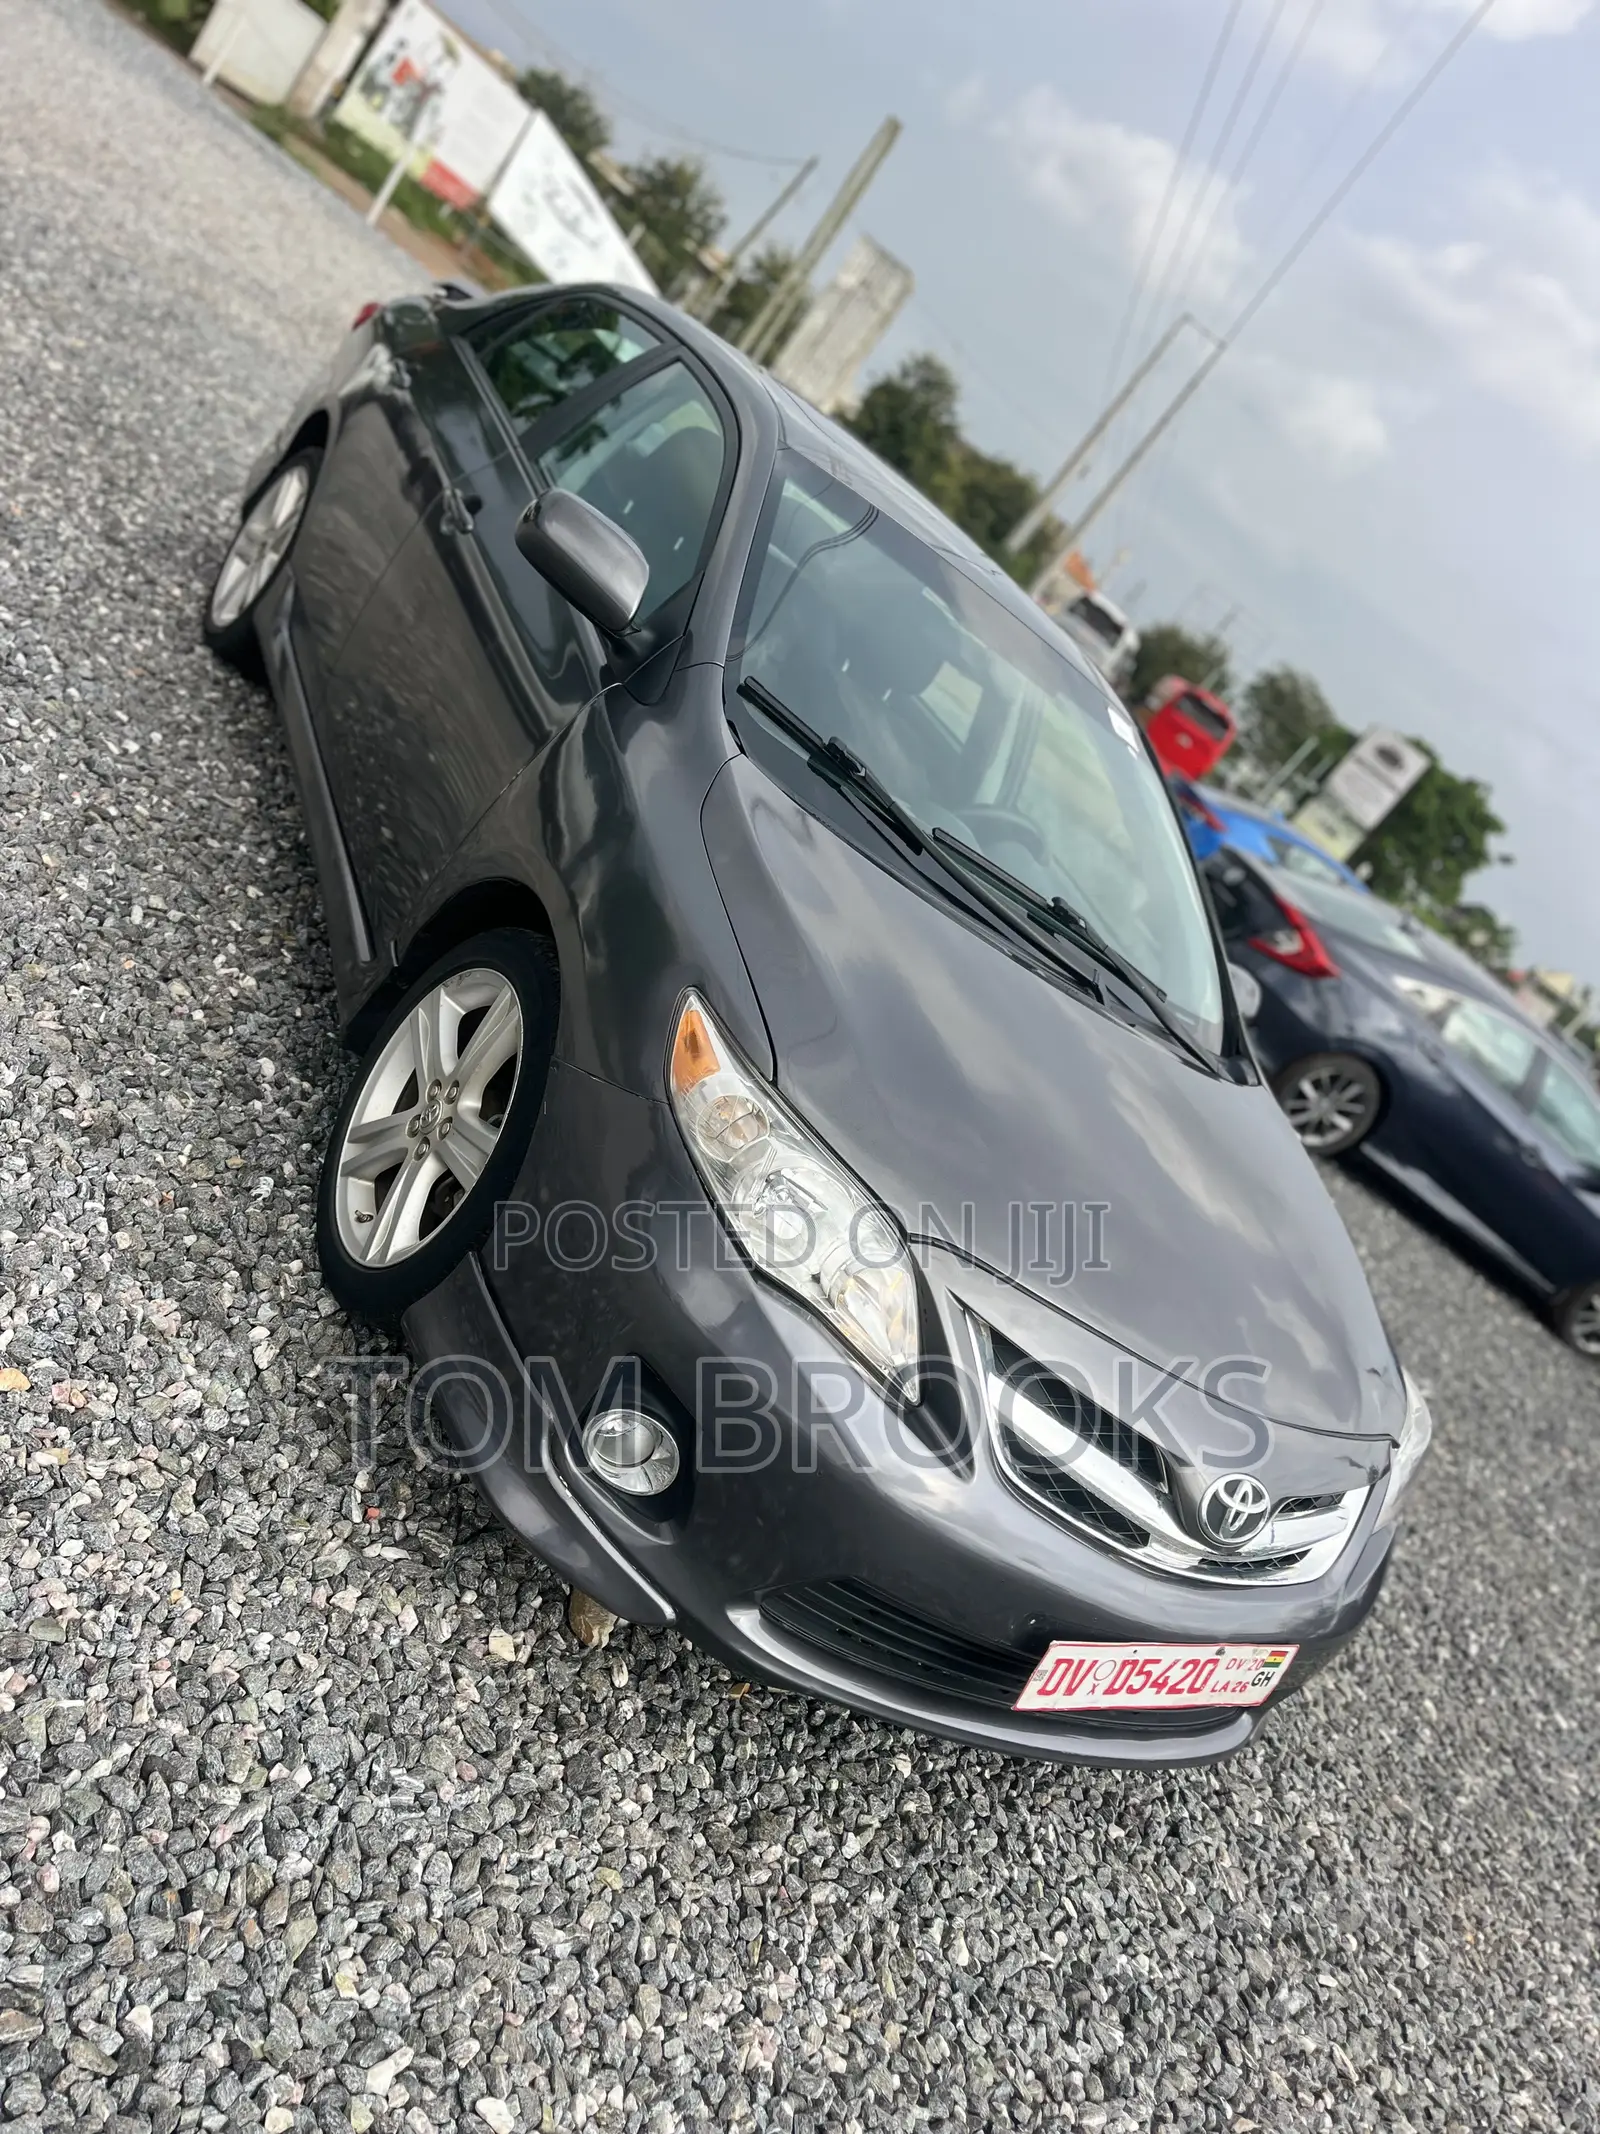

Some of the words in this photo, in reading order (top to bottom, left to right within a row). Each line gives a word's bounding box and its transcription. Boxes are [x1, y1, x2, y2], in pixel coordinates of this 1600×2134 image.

[1037, 1658, 1096, 1696] DV
[1102, 1658, 1221, 1695] D5420
[1251, 1671, 1276, 1687] GH
[1210, 1681, 1229, 1693] LA
[1231, 1681, 1250, 1693] 26
